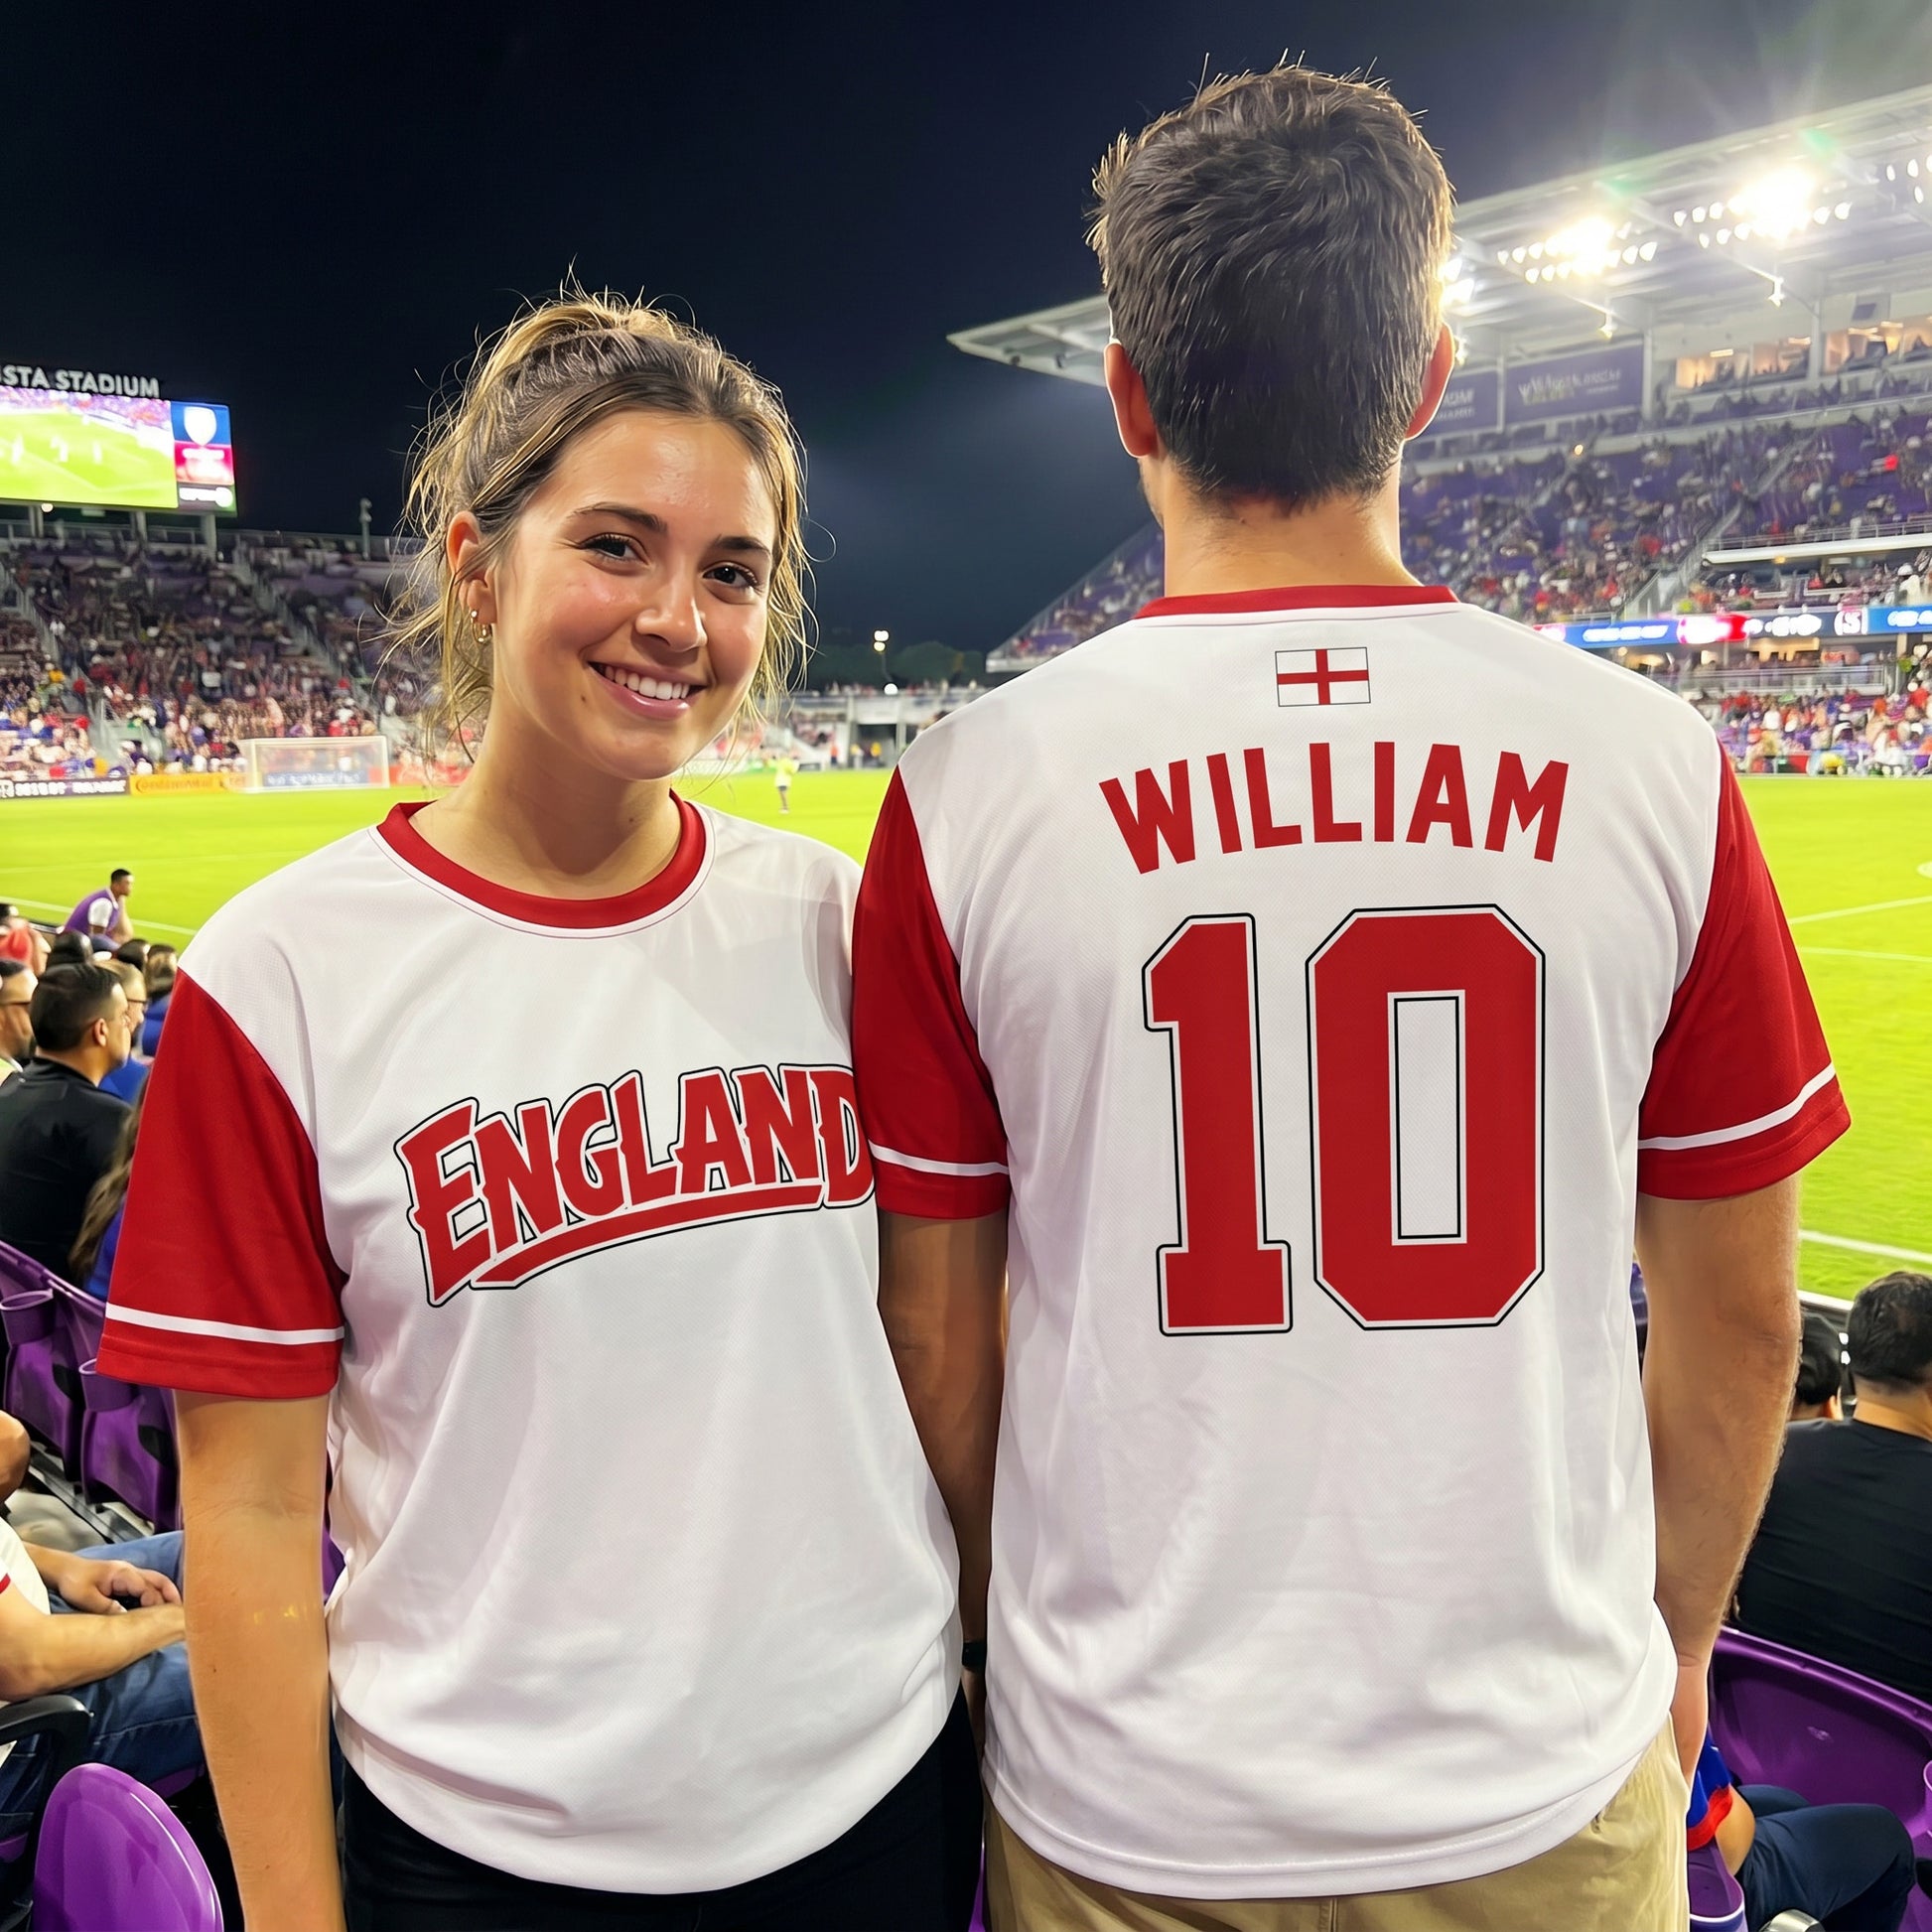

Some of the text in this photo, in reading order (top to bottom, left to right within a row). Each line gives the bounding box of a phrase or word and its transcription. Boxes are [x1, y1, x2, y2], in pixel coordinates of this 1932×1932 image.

[0, 364, 160, 397] STA STADIUM
[1099, 742, 1569, 874] WILLIAM
[394, 1063, 876, 1308] ENGLAND
[1142, 903, 1545, 1336] 10
